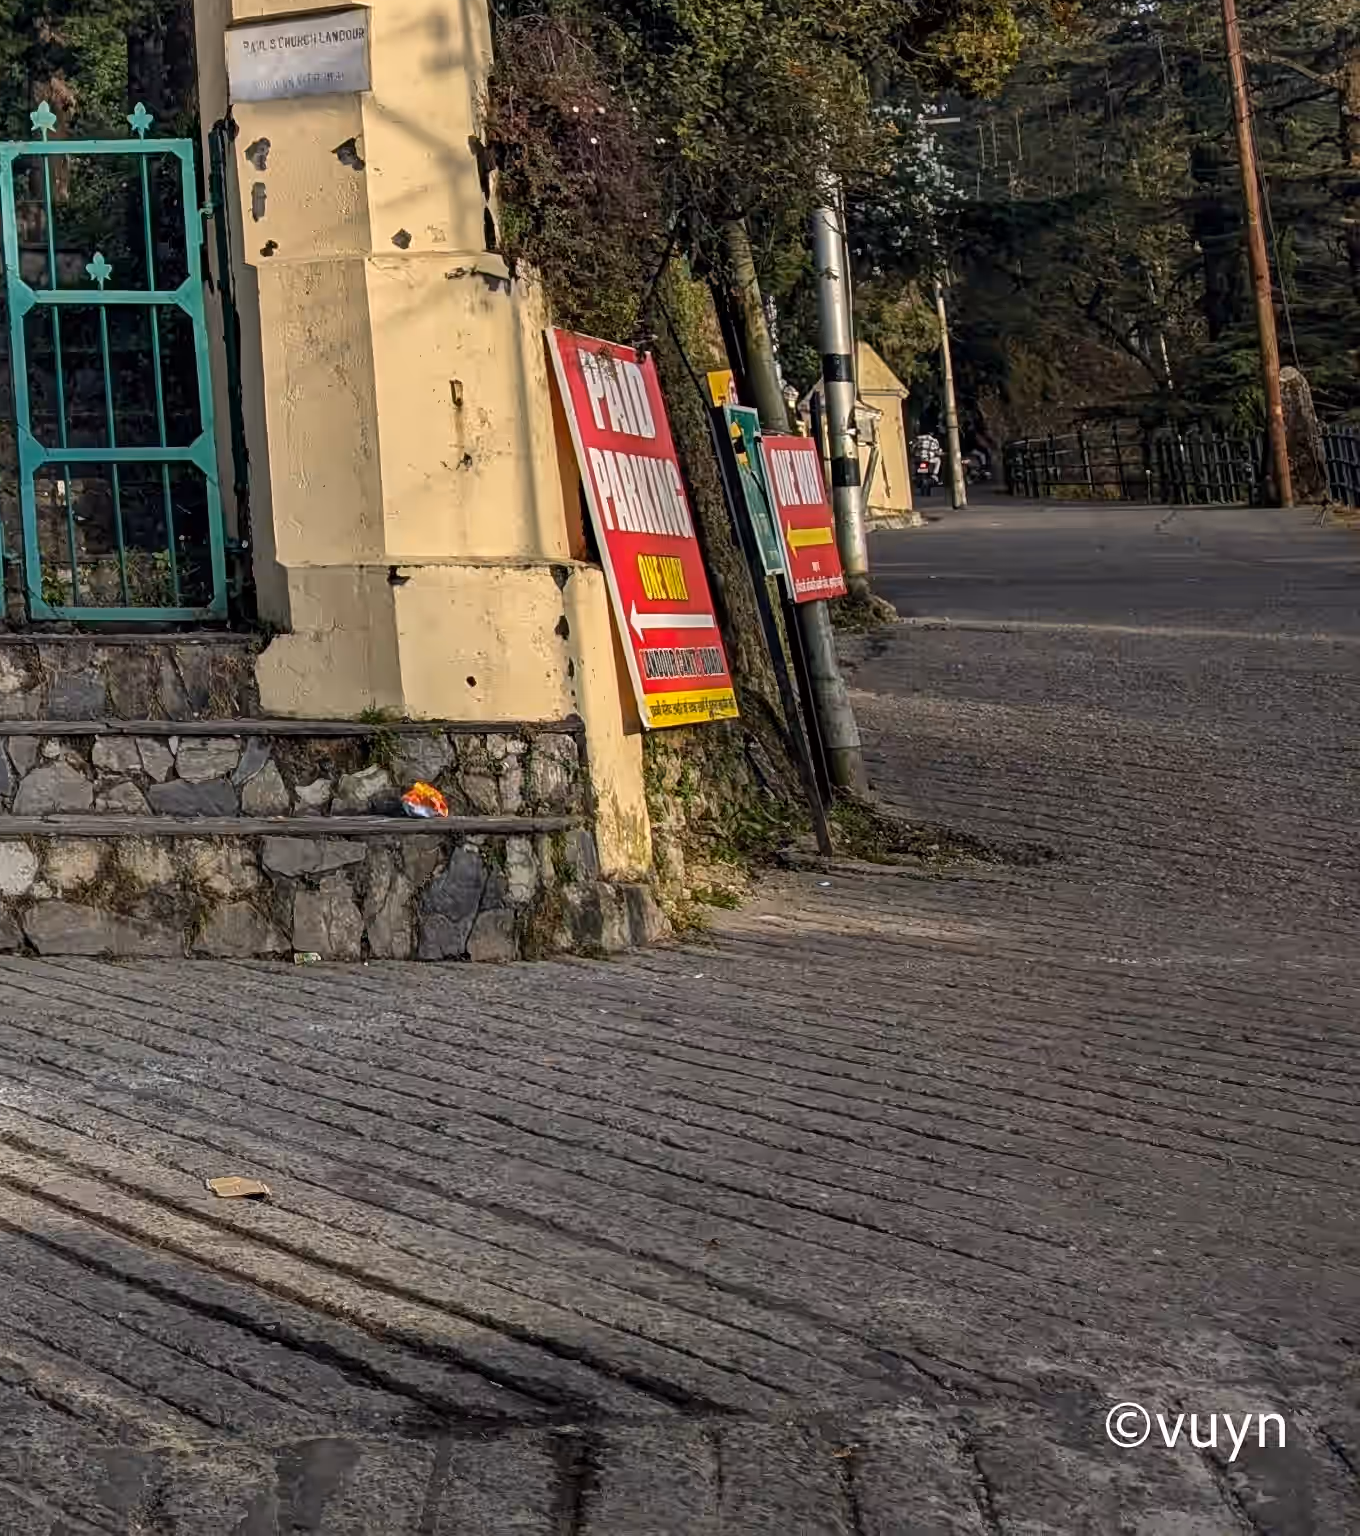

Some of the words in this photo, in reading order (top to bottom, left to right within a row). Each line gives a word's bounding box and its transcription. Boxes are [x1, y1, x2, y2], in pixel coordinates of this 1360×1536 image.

[577, 348, 656, 440] PAID
[586, 446, 696, 539] PARKING
[771, 449, 801, 507] ONE
[791, 450, 824, 505] WAY
[637, 553, 667, 600] ONE
[659, 555, 689, 601] WAY
